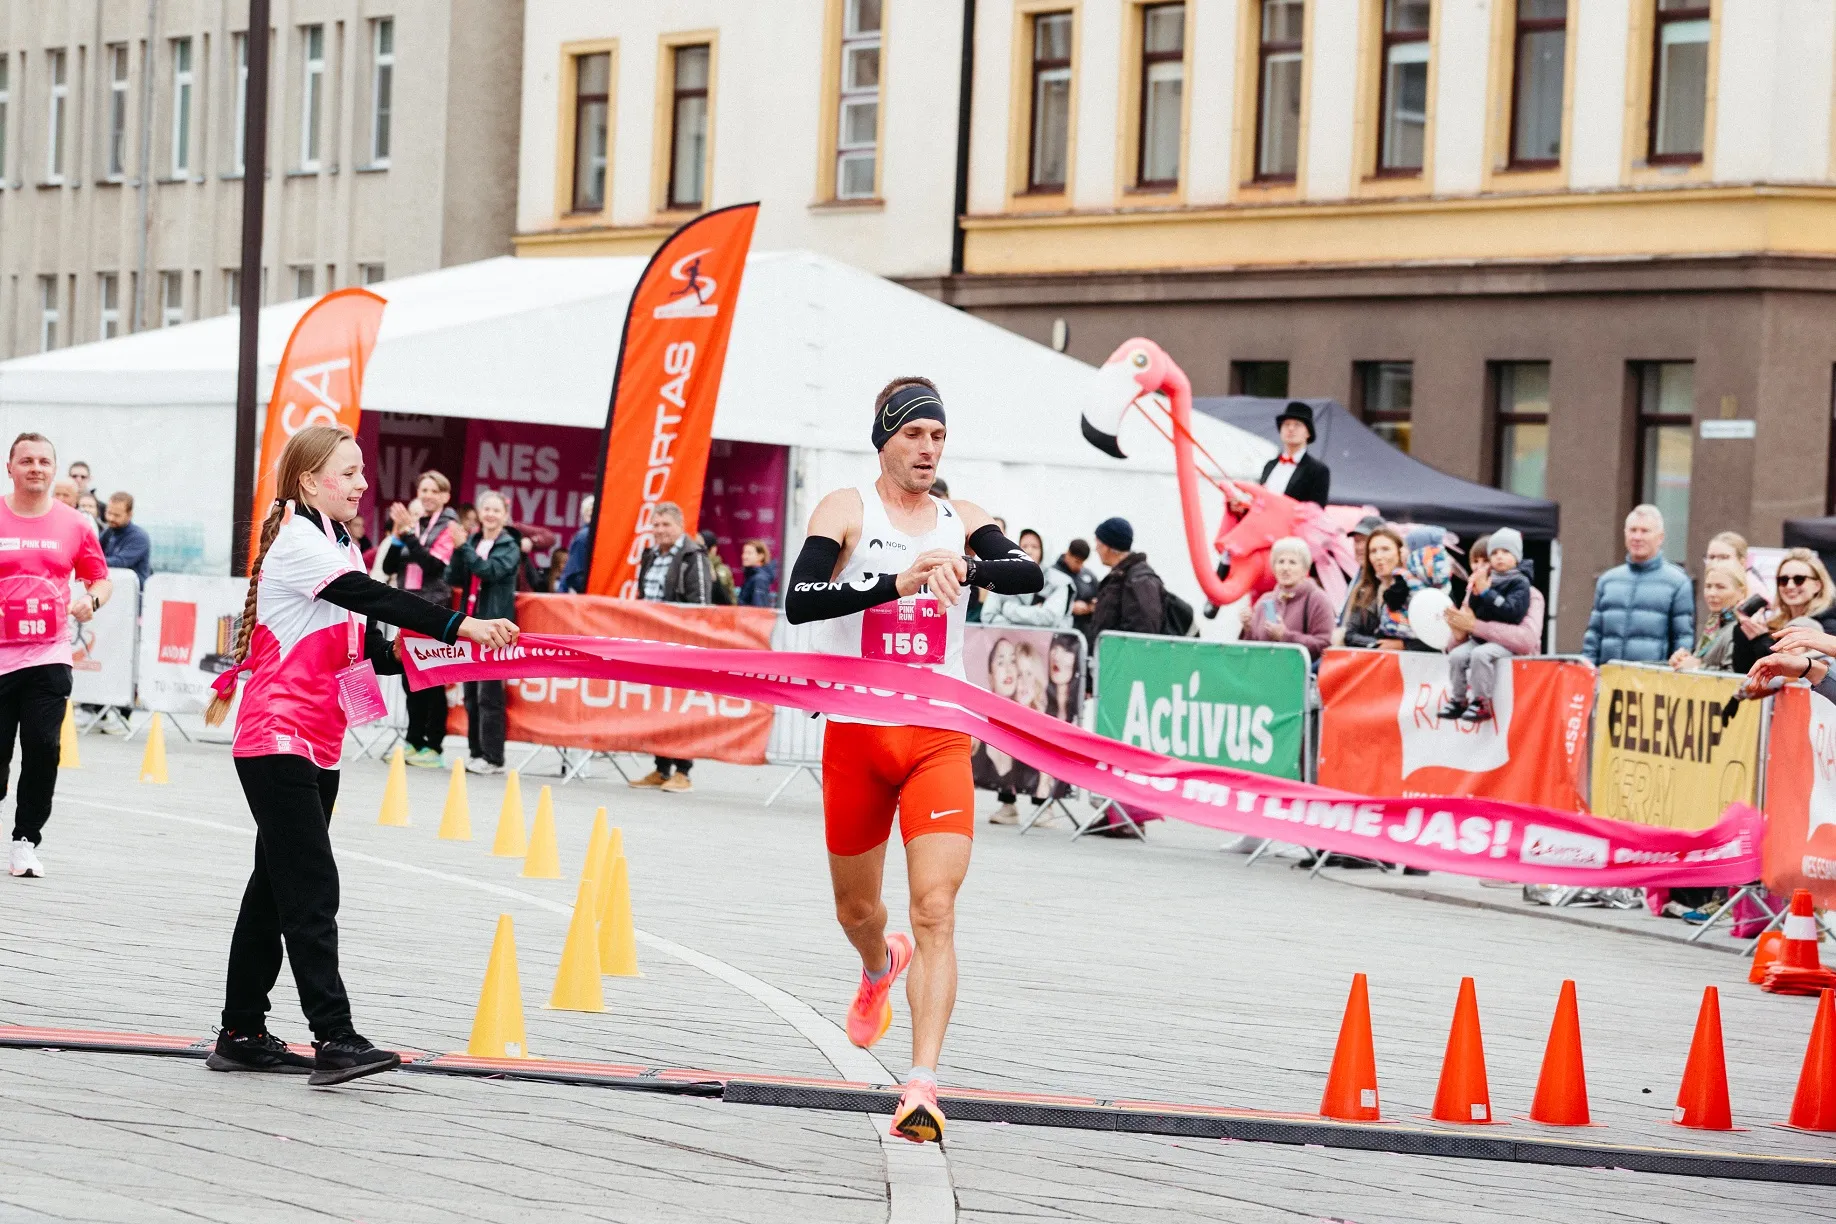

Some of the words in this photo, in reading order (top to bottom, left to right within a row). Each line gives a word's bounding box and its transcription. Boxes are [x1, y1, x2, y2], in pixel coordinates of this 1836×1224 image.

[282, 358, 351, 437] SA
[476, 441, 560, 484] NES
[885, 541, 907, 551] NORD
[18, 620, 47, 635] 518
[921, 607, 934, 618] 10
[882, 633, 929, 656] 156
[1122, 670, 1275, 764] Activus
[1608, 688, 1723, 764] BELEKAIP
[1387, 807, 1513, 858] JAS!
